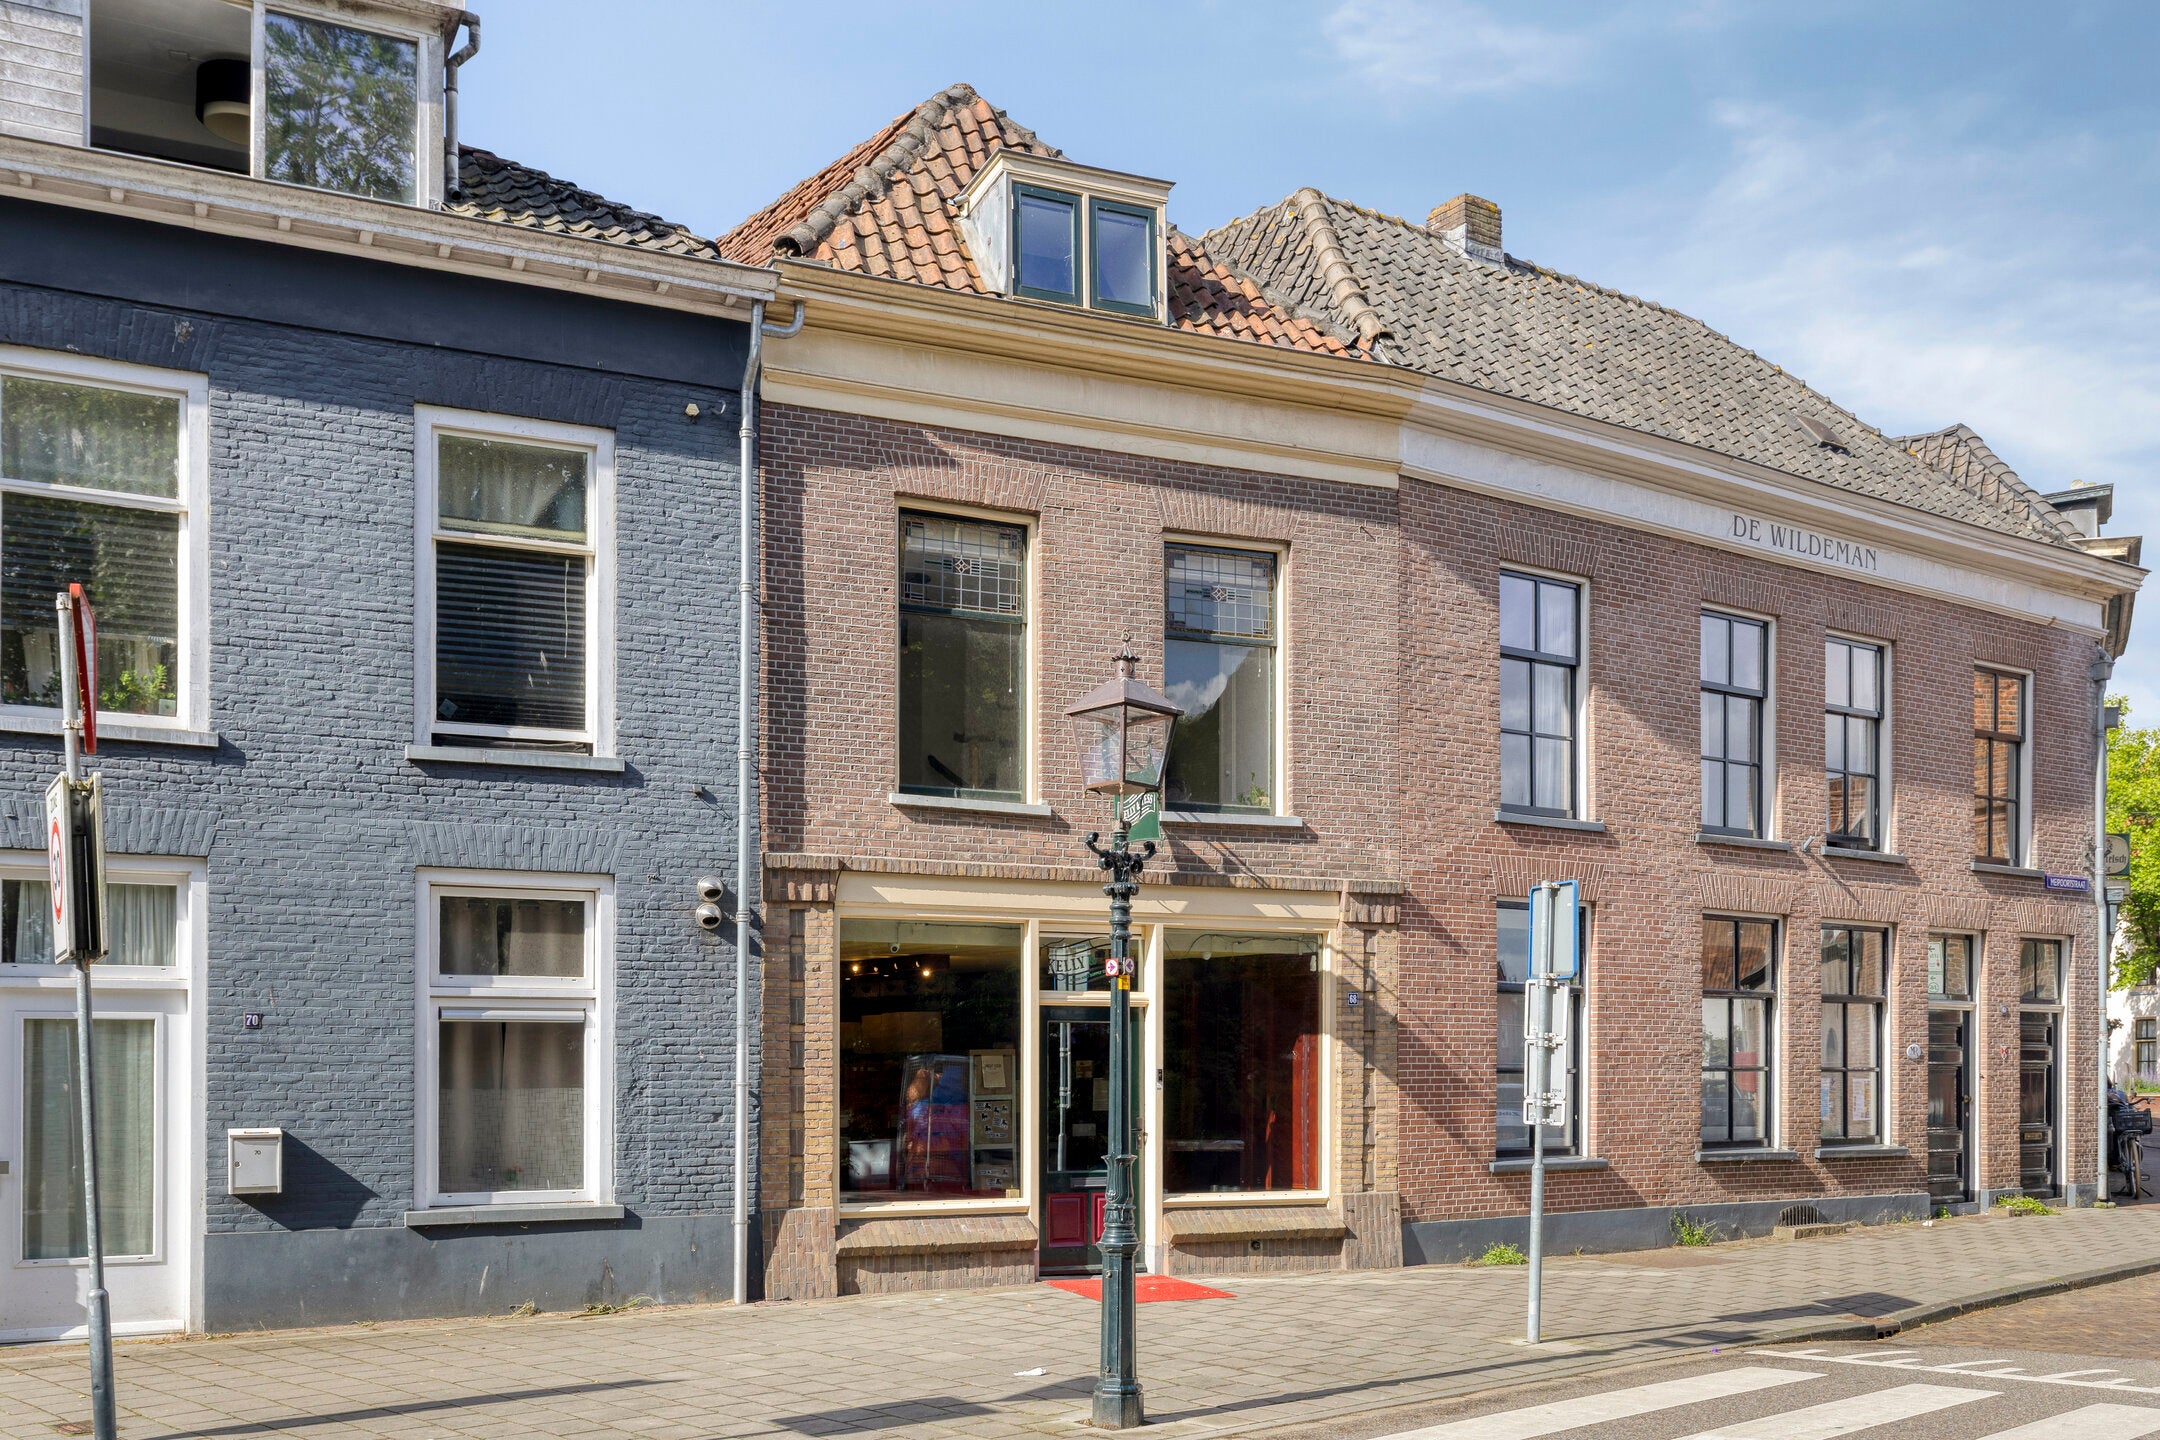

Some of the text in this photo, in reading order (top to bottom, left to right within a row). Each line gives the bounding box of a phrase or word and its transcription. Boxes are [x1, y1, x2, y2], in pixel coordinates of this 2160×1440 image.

[1733, 514, 1878, 571] DE WILDEMAN
[1048, 956, 1086, 975] KELLY
[246, 1014, 259, 1026] 70
